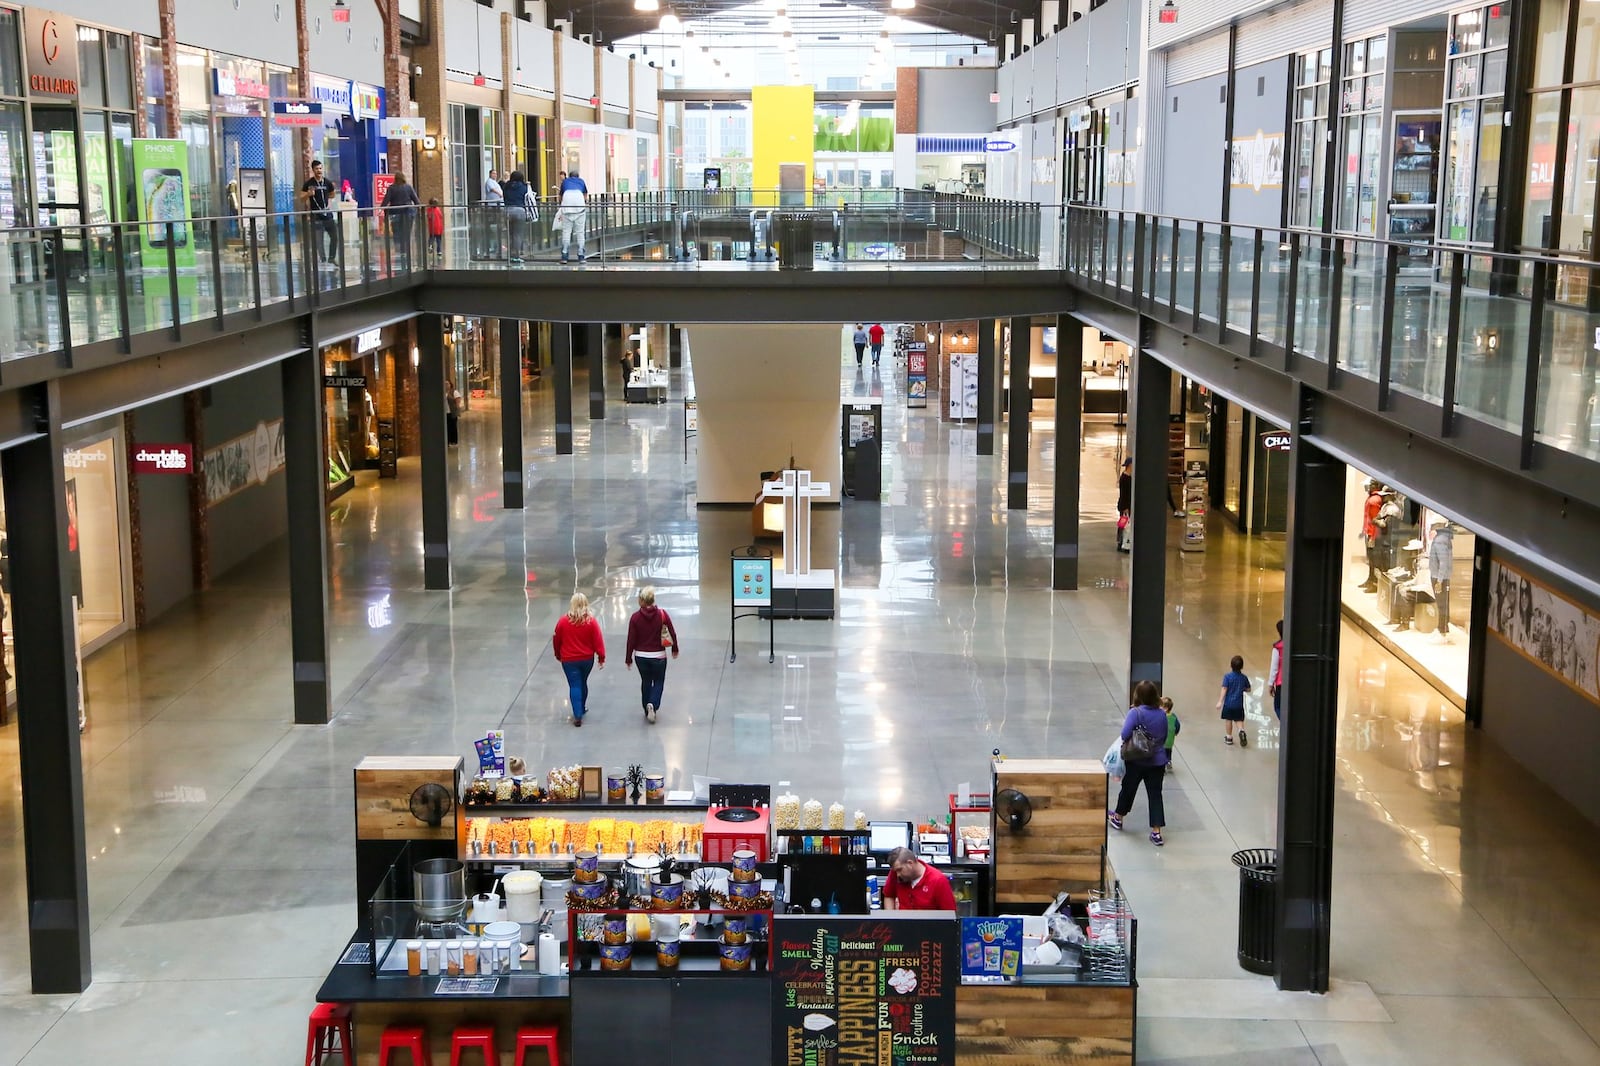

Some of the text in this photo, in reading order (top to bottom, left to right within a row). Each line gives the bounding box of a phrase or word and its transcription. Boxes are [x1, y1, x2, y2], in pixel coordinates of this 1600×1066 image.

[31, 74, 78, 95] CELLAIRIS
[286, 102, 310, 114] kids
[144, 144, 176, 153] PHONE
[1530, 162, 1556, 184] SAL
[377, 180, 384, 188] 2
[326, 378, 366, 387] zumiez
[136, 449, 186, 461] charlotte
[156, 460, 187, 469] russe
[810, 928, 829, 970] Wedding
[841, 941, 876, 950] Delicious!
[886, 958, 920, 967] FRESH
[918, 940, 930, 997] Popcorn
[930, 942, 942, 997] Pizzazz
[825, 954, 835, 996] MEMORIES
[785, 988, 797, 1008] kids
[838, 960, 876, 1066] HAPPINESS
[879, 1001, 892, 1030] FUN
[910, 1003, 923, 1037] culture
[788, 1025, 804, 1066] UTTY
[804, 1033, 838, 1049] smiles
[893, 1032, 938, 1045] Snack
